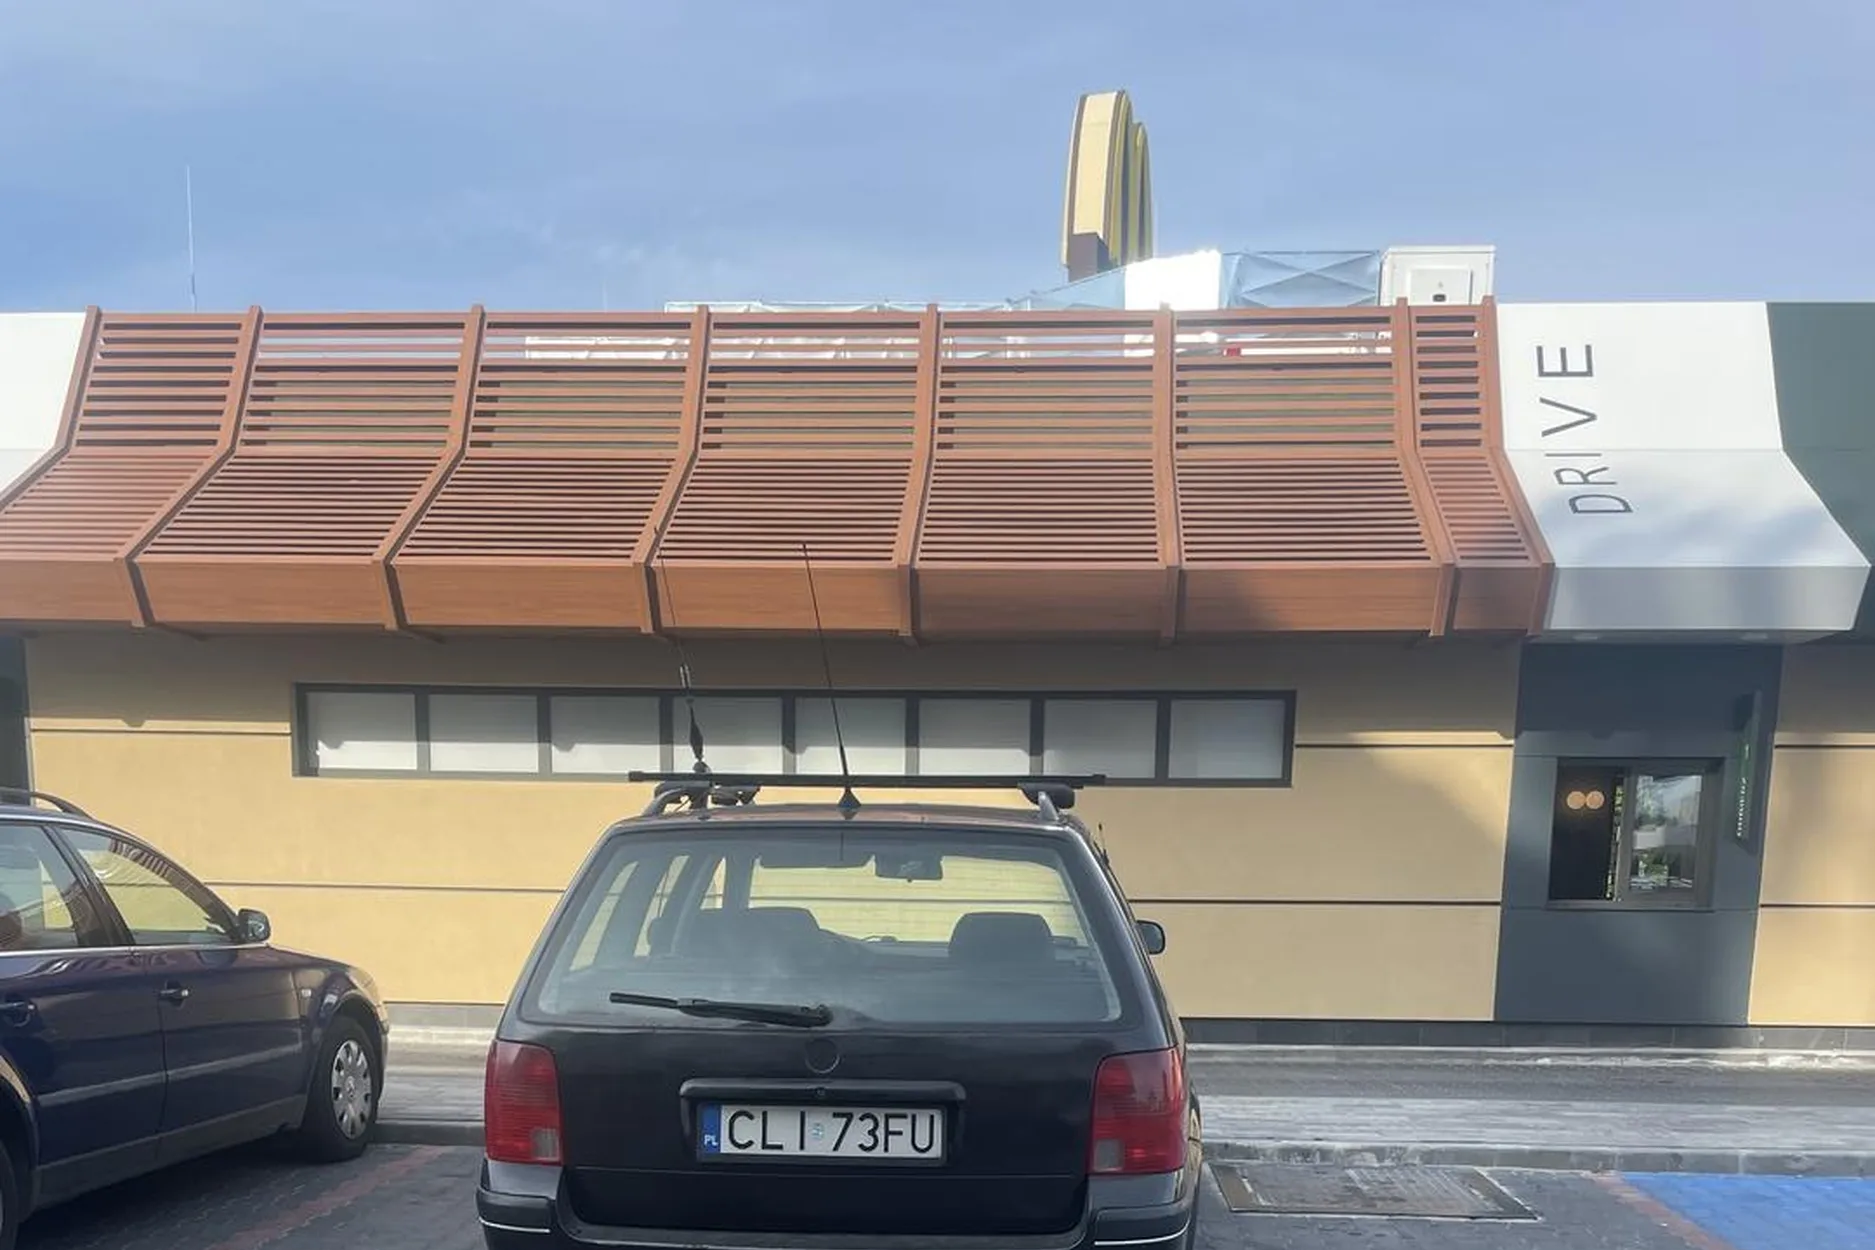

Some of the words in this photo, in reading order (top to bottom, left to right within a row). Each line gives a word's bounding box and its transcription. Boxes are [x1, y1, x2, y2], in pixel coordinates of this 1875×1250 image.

[1536, 344, 1633, 514] DRIVE
[704, 1134, 719, 1147] PL
[728, 1109, 805, 1151] CLI
[832, 1112, 935, 1154] 73FU
